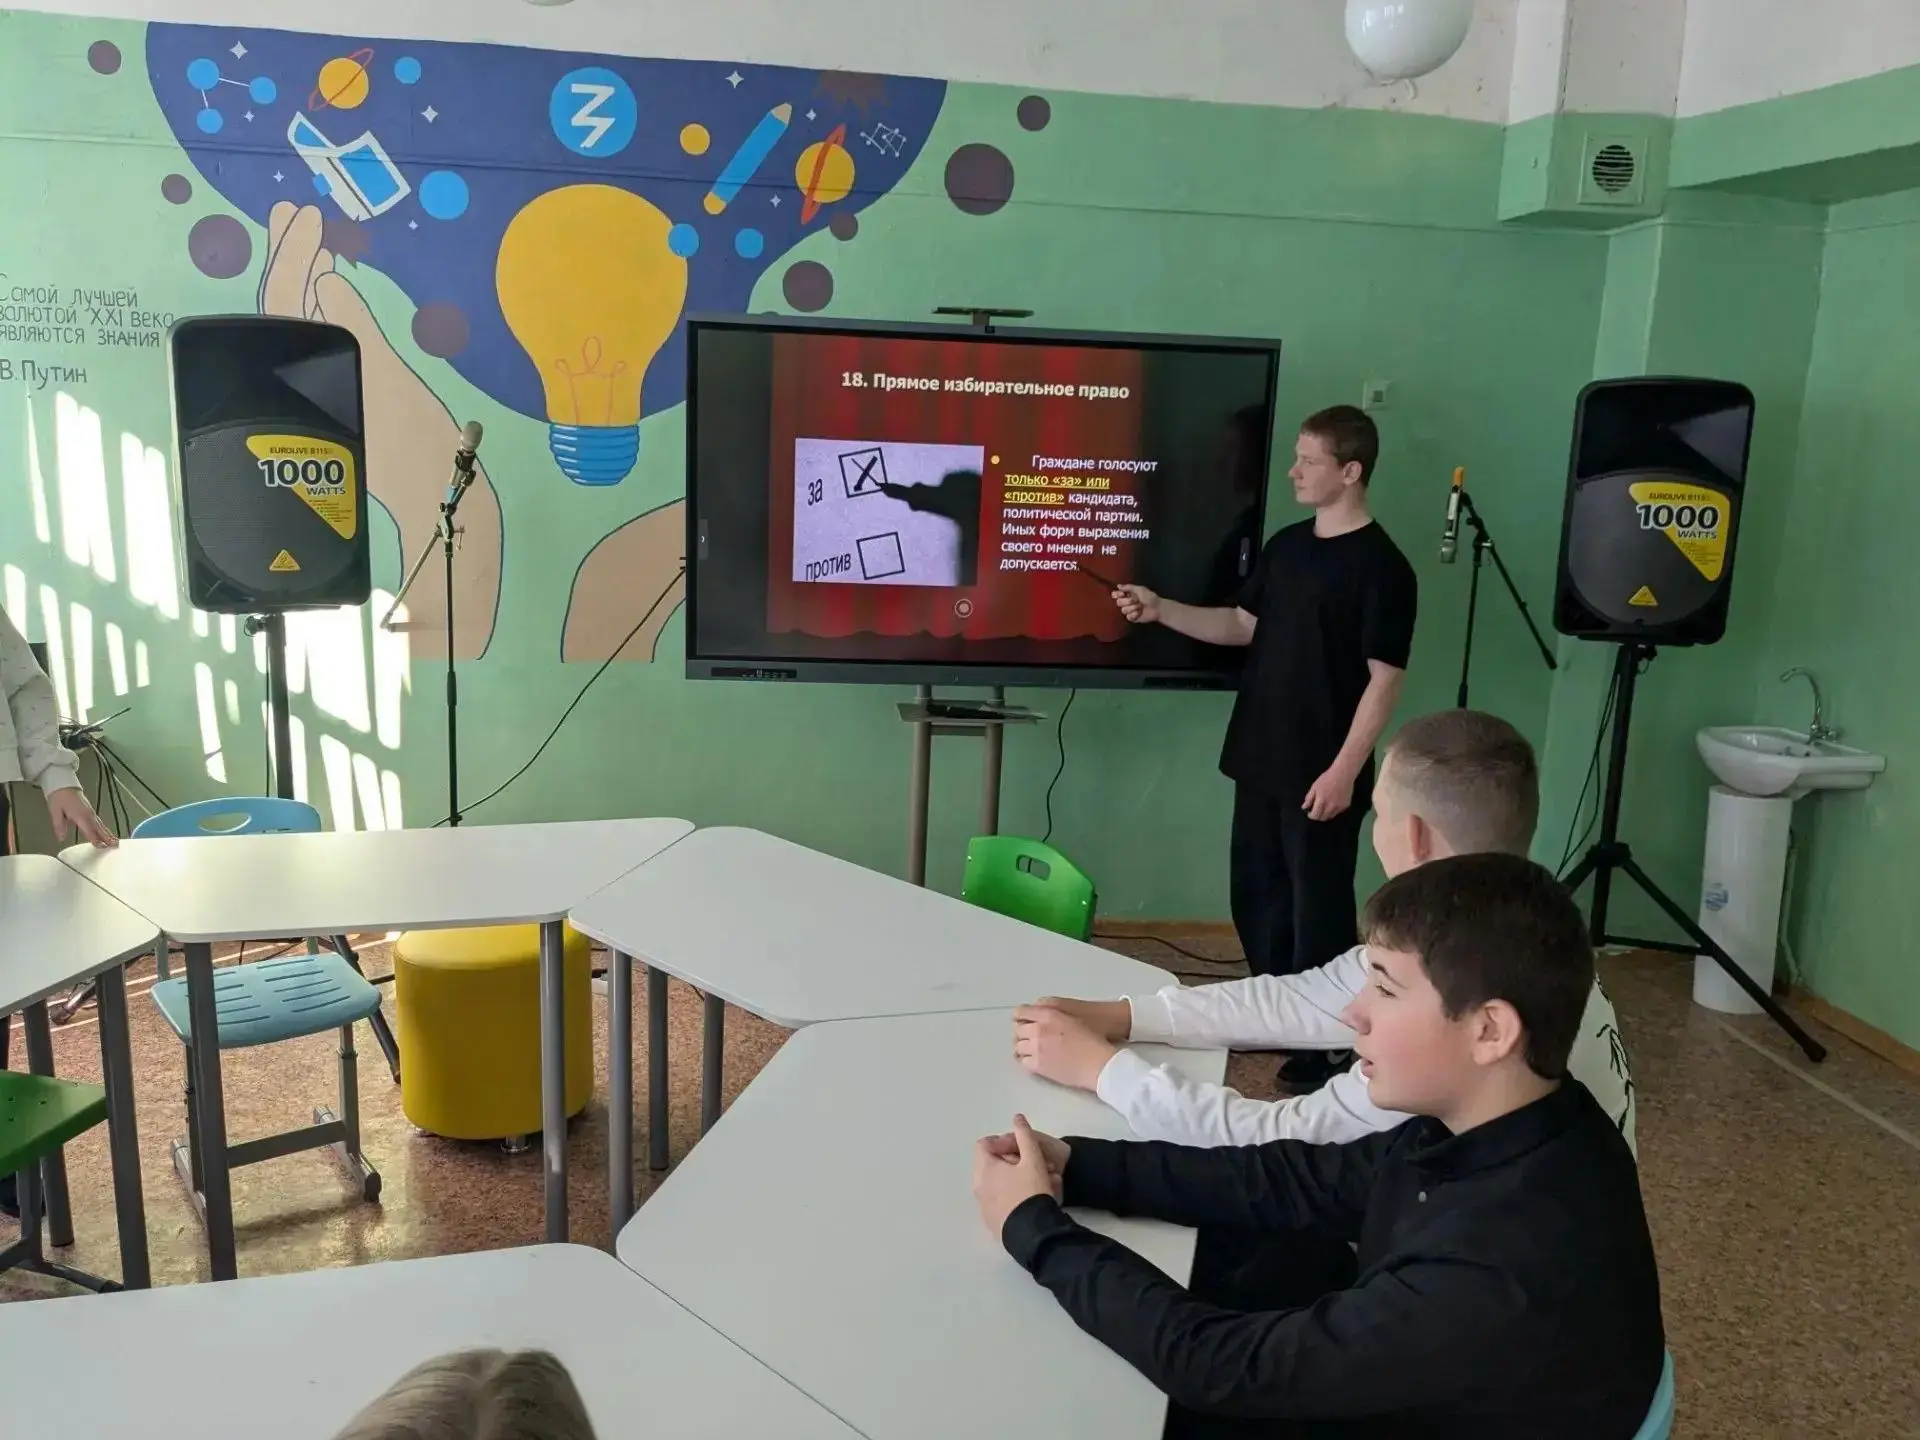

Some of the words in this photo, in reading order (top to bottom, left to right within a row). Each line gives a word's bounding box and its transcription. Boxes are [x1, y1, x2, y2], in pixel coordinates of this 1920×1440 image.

[71, 287, 138, 312] лучшей
[841, 372, 869, 387] 18.
[873, 373, 940, 391] Прямое
[944, 378, 1075, 396] избирательное
[1078, 385, 1130, 399] право
[258, 458, 346, 487] 1000
[1032, 455, 1096, 470] Граждане
[1098, 460, 1158, 474] голосуют
[1004, 474, 1049, 486] только
[1053, 475, 1082, 487] «за»
[1086, 477, 1110, 488] или
[305, 487, 346, 495] WATTS
[808, 478, 824, 506] за
[1004, 490, 1065, 502] «против»
[1068, 492, 1138, 507] кандидата,
[1003, 507, 1091, 520] политической
[1095, 510, 1144, 524] партии.
[1636, 504, 1720, 530] 1000
[1002, 522, 1036, 535] Иных
[1039, 523, 1074, 538] форм
[1078, 527, 1150, 540] выражения
[1677, 530, 1718, 539] WATTS
[1001, 541, 1043, 553] своего
[1047, 544, 1094, 555] мнения
[1101, 544, 1117, 556] не
[805, 553, 852, 584] против
